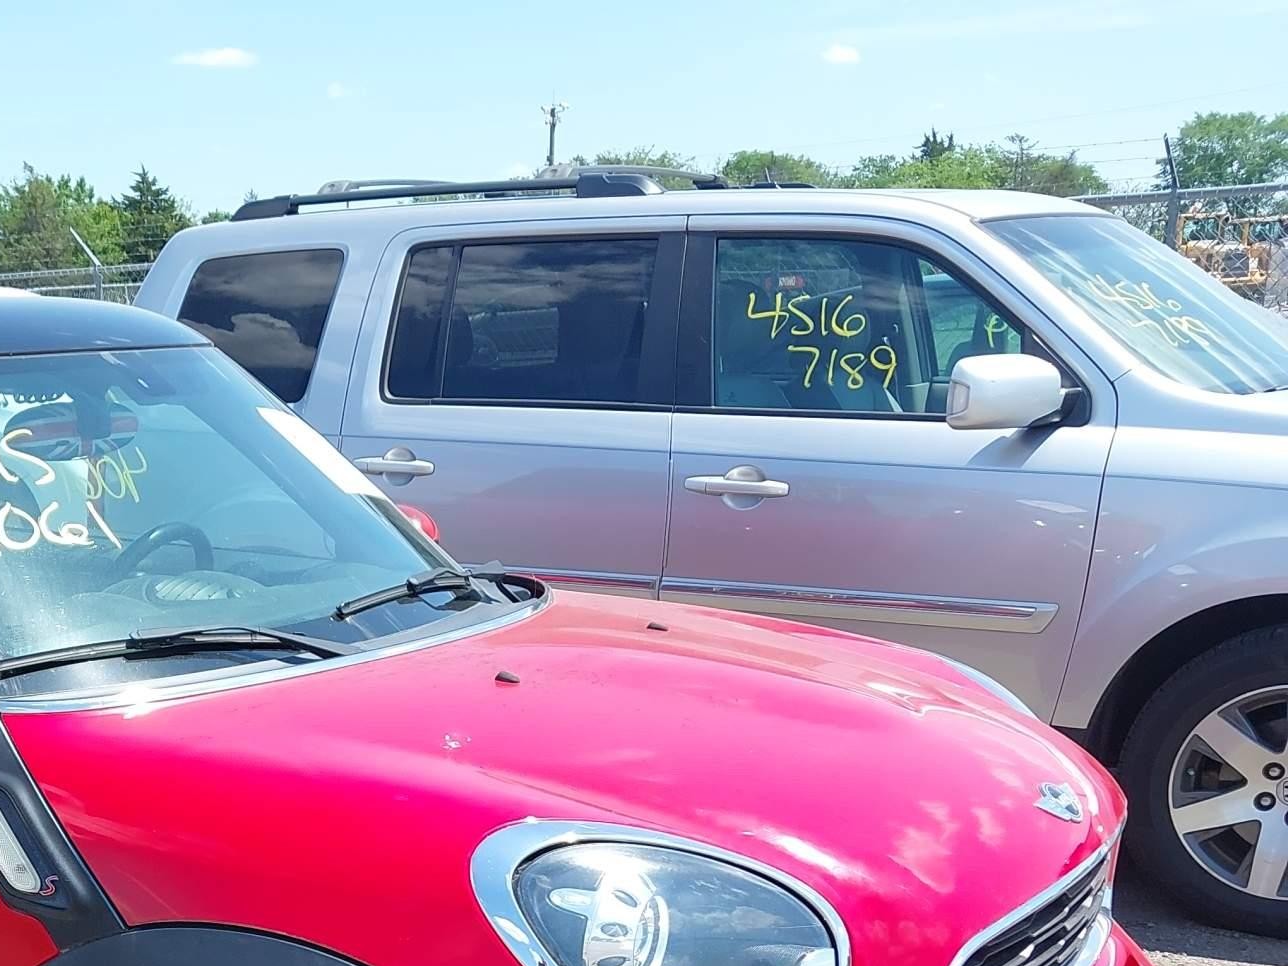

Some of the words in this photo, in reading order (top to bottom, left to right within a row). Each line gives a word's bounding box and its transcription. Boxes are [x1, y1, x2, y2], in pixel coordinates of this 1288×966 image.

[746, 291, 866, 339] 4516
[787, 345, 897, 390] 7189
[39, 875, 59, 896] S
